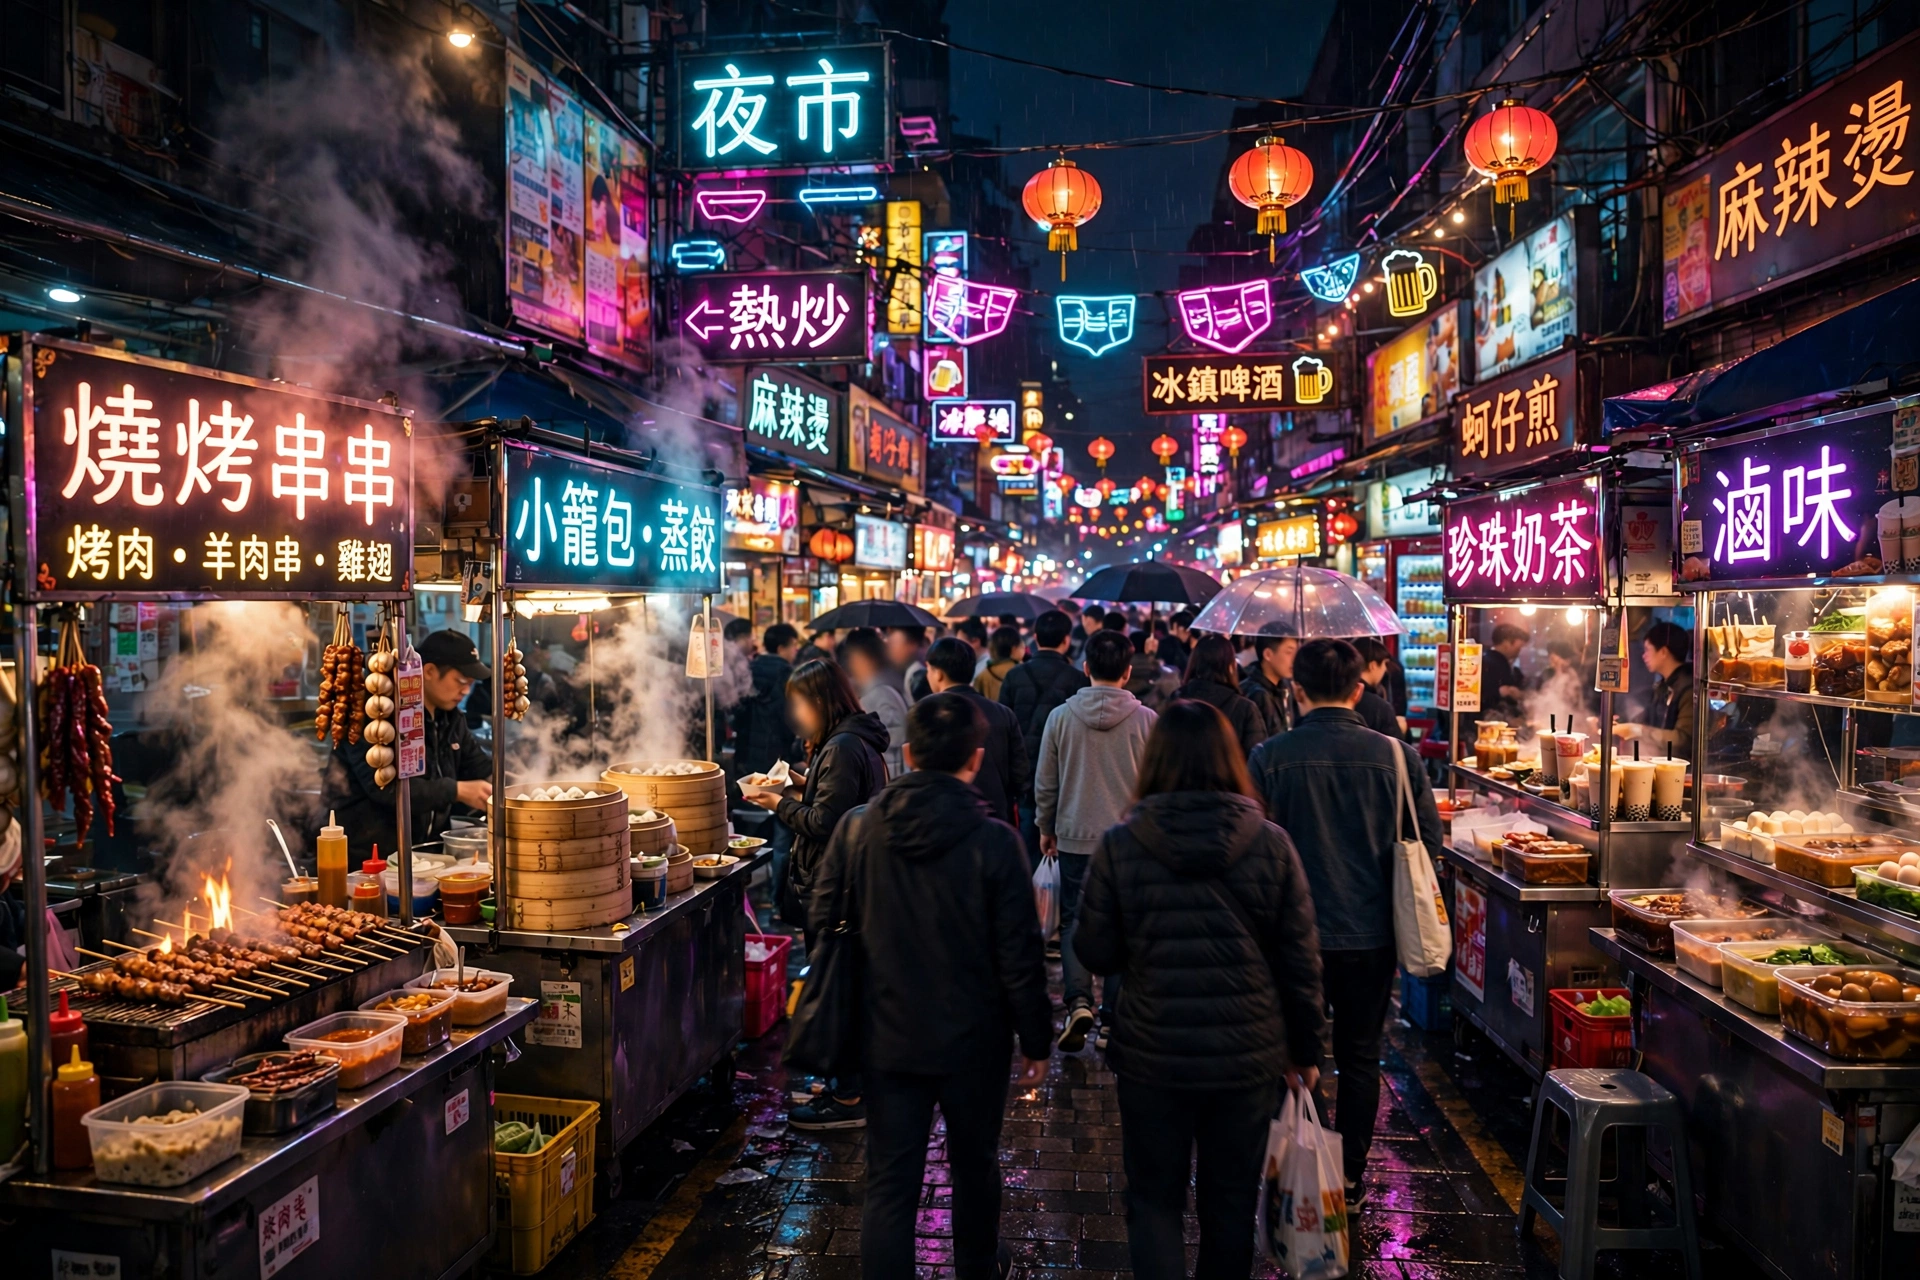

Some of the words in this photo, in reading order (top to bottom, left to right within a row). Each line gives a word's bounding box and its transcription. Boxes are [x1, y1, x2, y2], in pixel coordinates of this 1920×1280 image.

[692, 58, 870, 158] 夜市
[1714, 80, 1914, 261] 麻辣燙
[729, 283, 850, 350] 熱炒
[748, 372, 829, 455] 麻辣燙
[1152, 364, 1283, 404] 冰鎮啤酒
[1461, 373, 1559, 460] 蚵仔煎
[62, 382, 394, 526] 燒烤串串
[1447, 499, 1592, 588] 珍珠奶茶
[1712, 445, 1858, 565] 滷味
